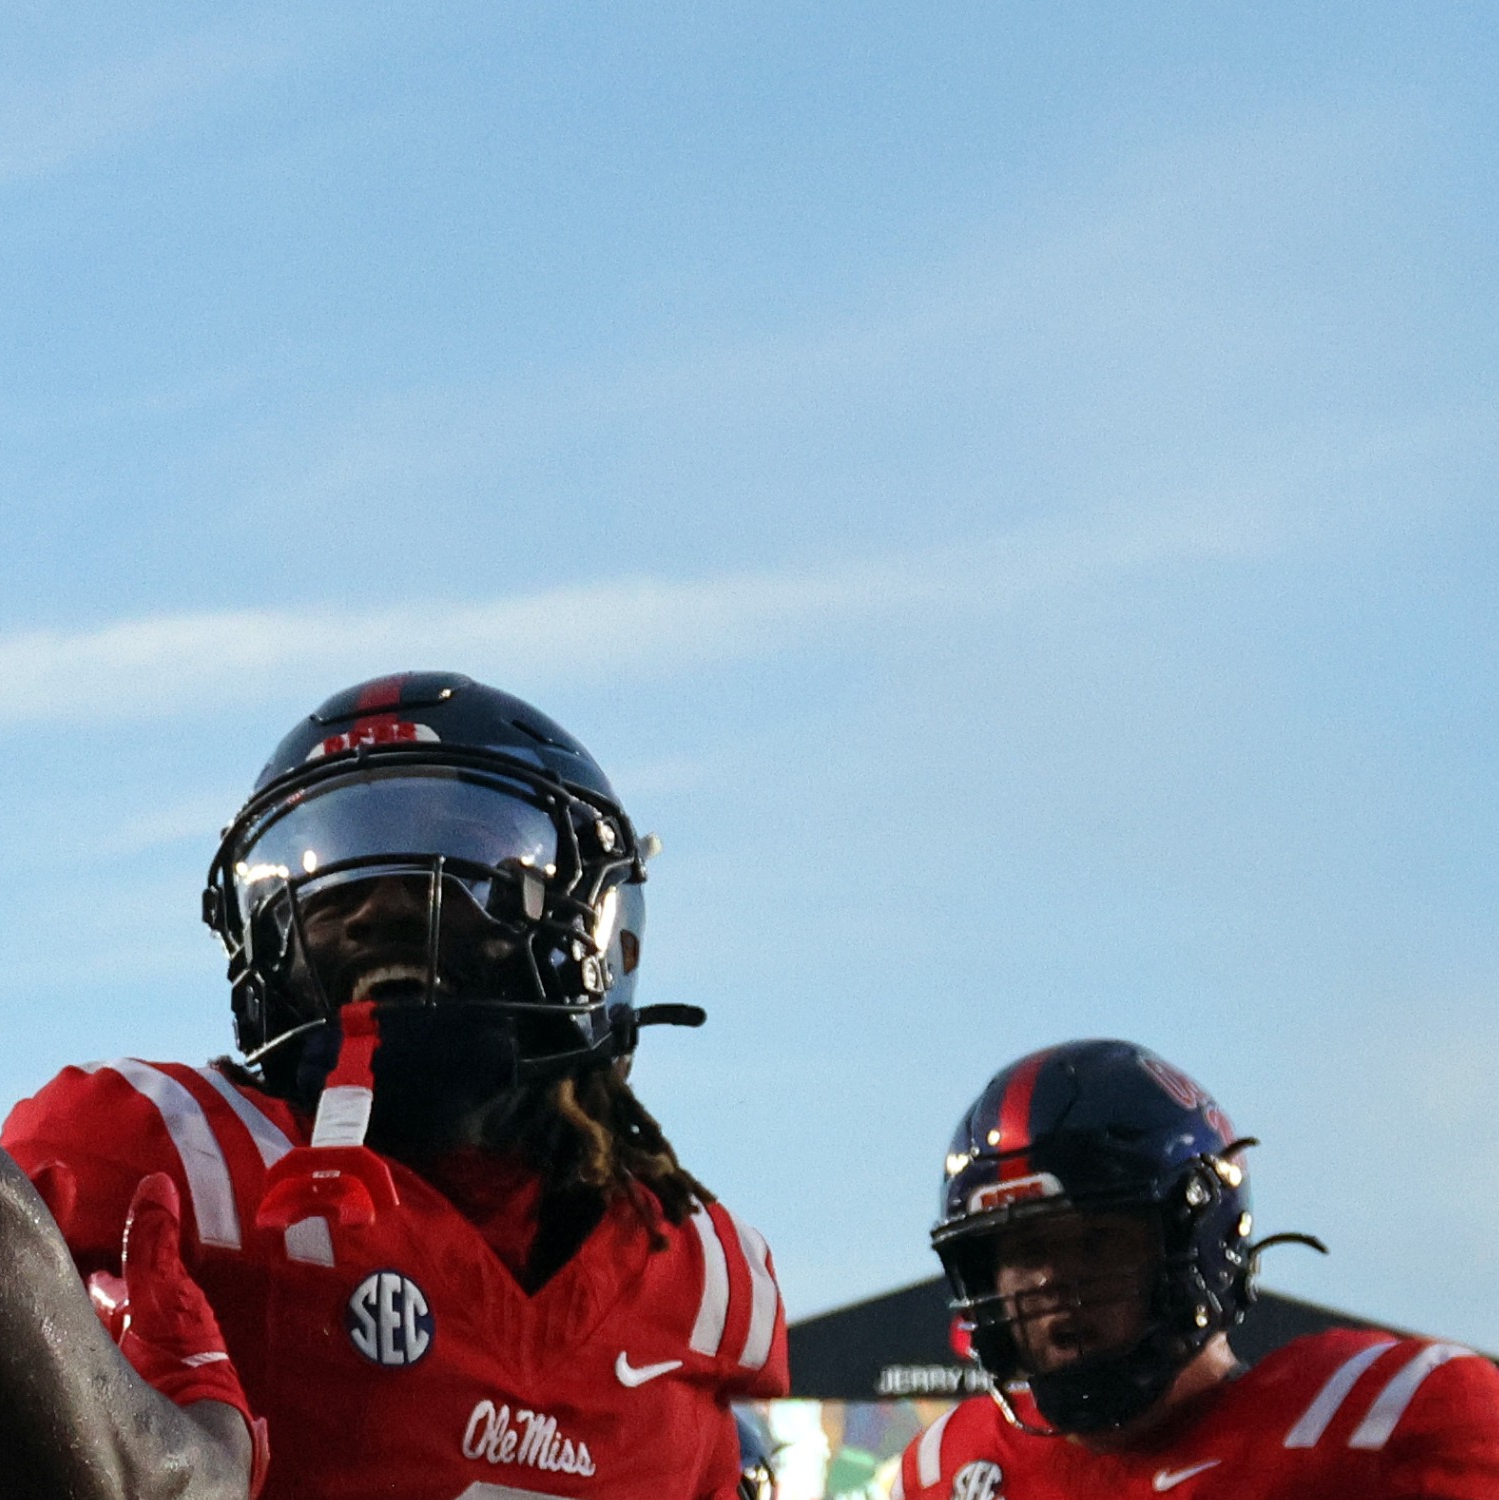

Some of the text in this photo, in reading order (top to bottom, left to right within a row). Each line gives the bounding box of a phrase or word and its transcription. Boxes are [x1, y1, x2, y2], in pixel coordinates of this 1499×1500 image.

[350, 1272, 430, 1365] SEC
[463, 1399, 596, 1477] Ole Miss
